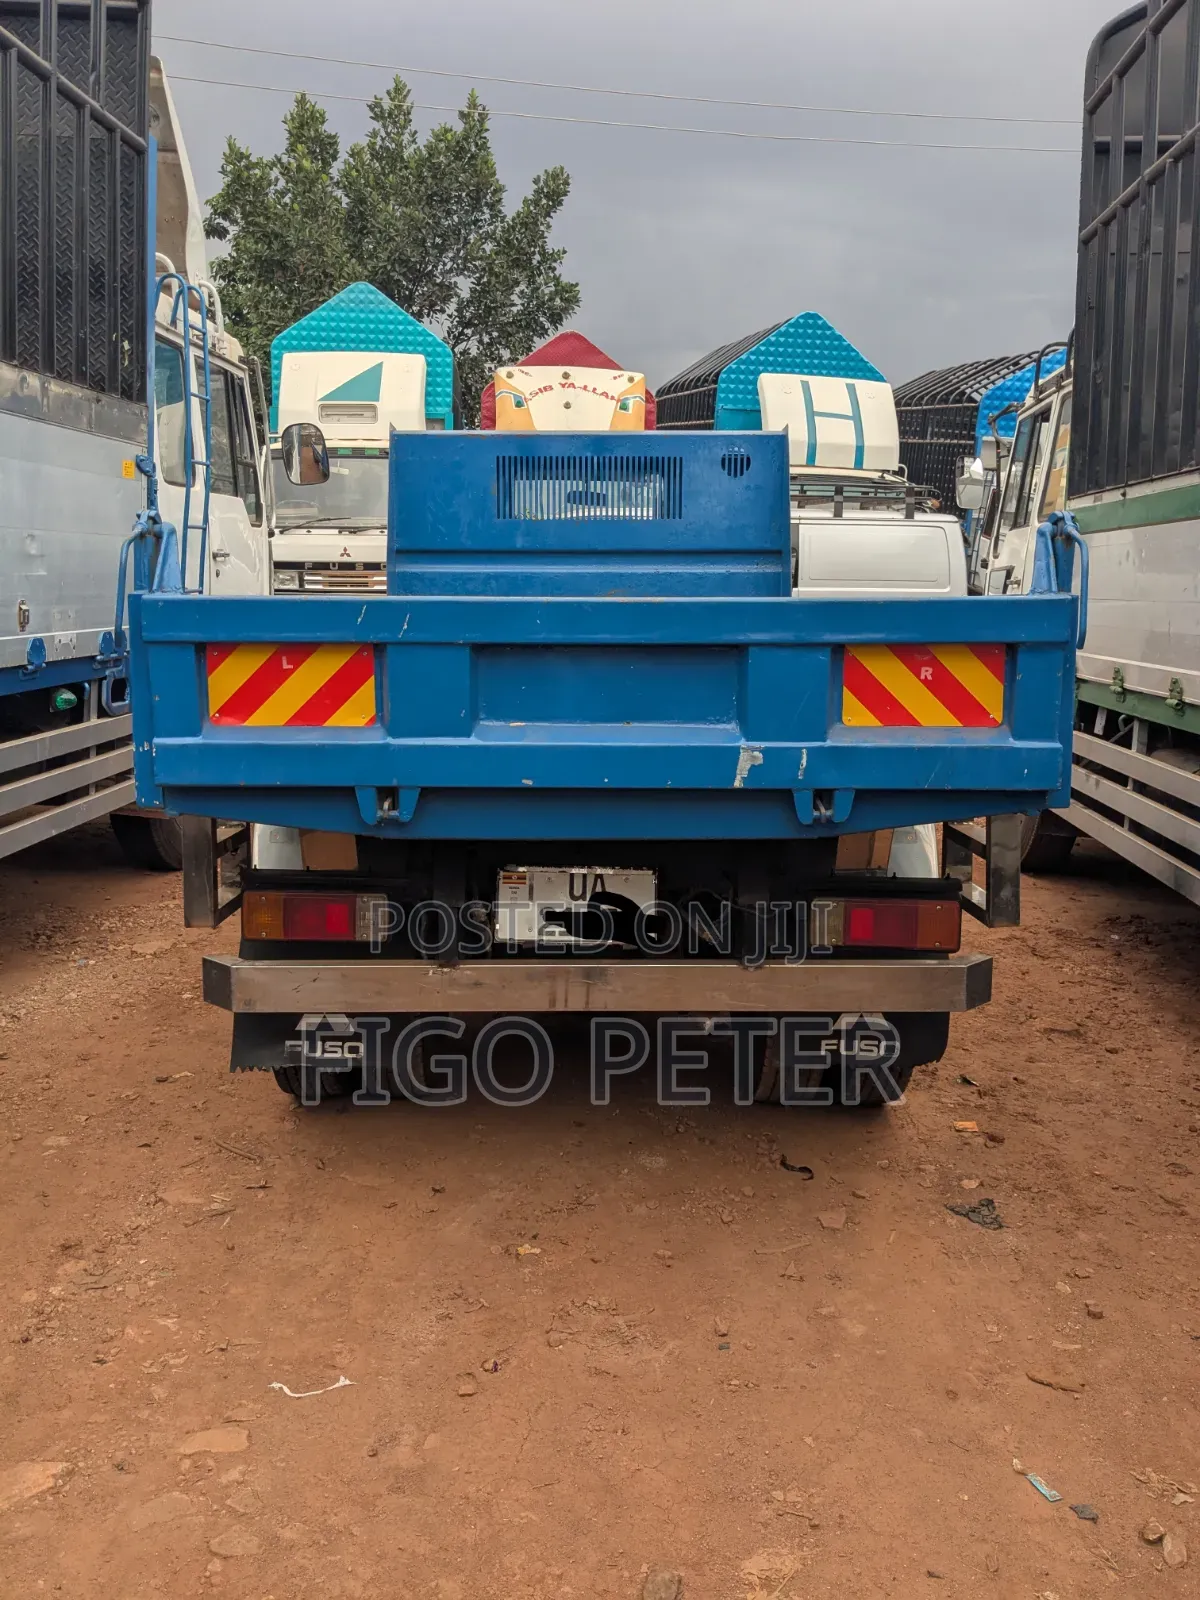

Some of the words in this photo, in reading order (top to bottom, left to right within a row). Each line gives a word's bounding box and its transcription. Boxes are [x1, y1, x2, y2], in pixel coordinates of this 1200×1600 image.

[282, 656, 293, 669] L
[920, 666, 933, 680] R
[284, 1040, 364, 1058] FUSO
[820, 1040, 900, 1057] FUSO
